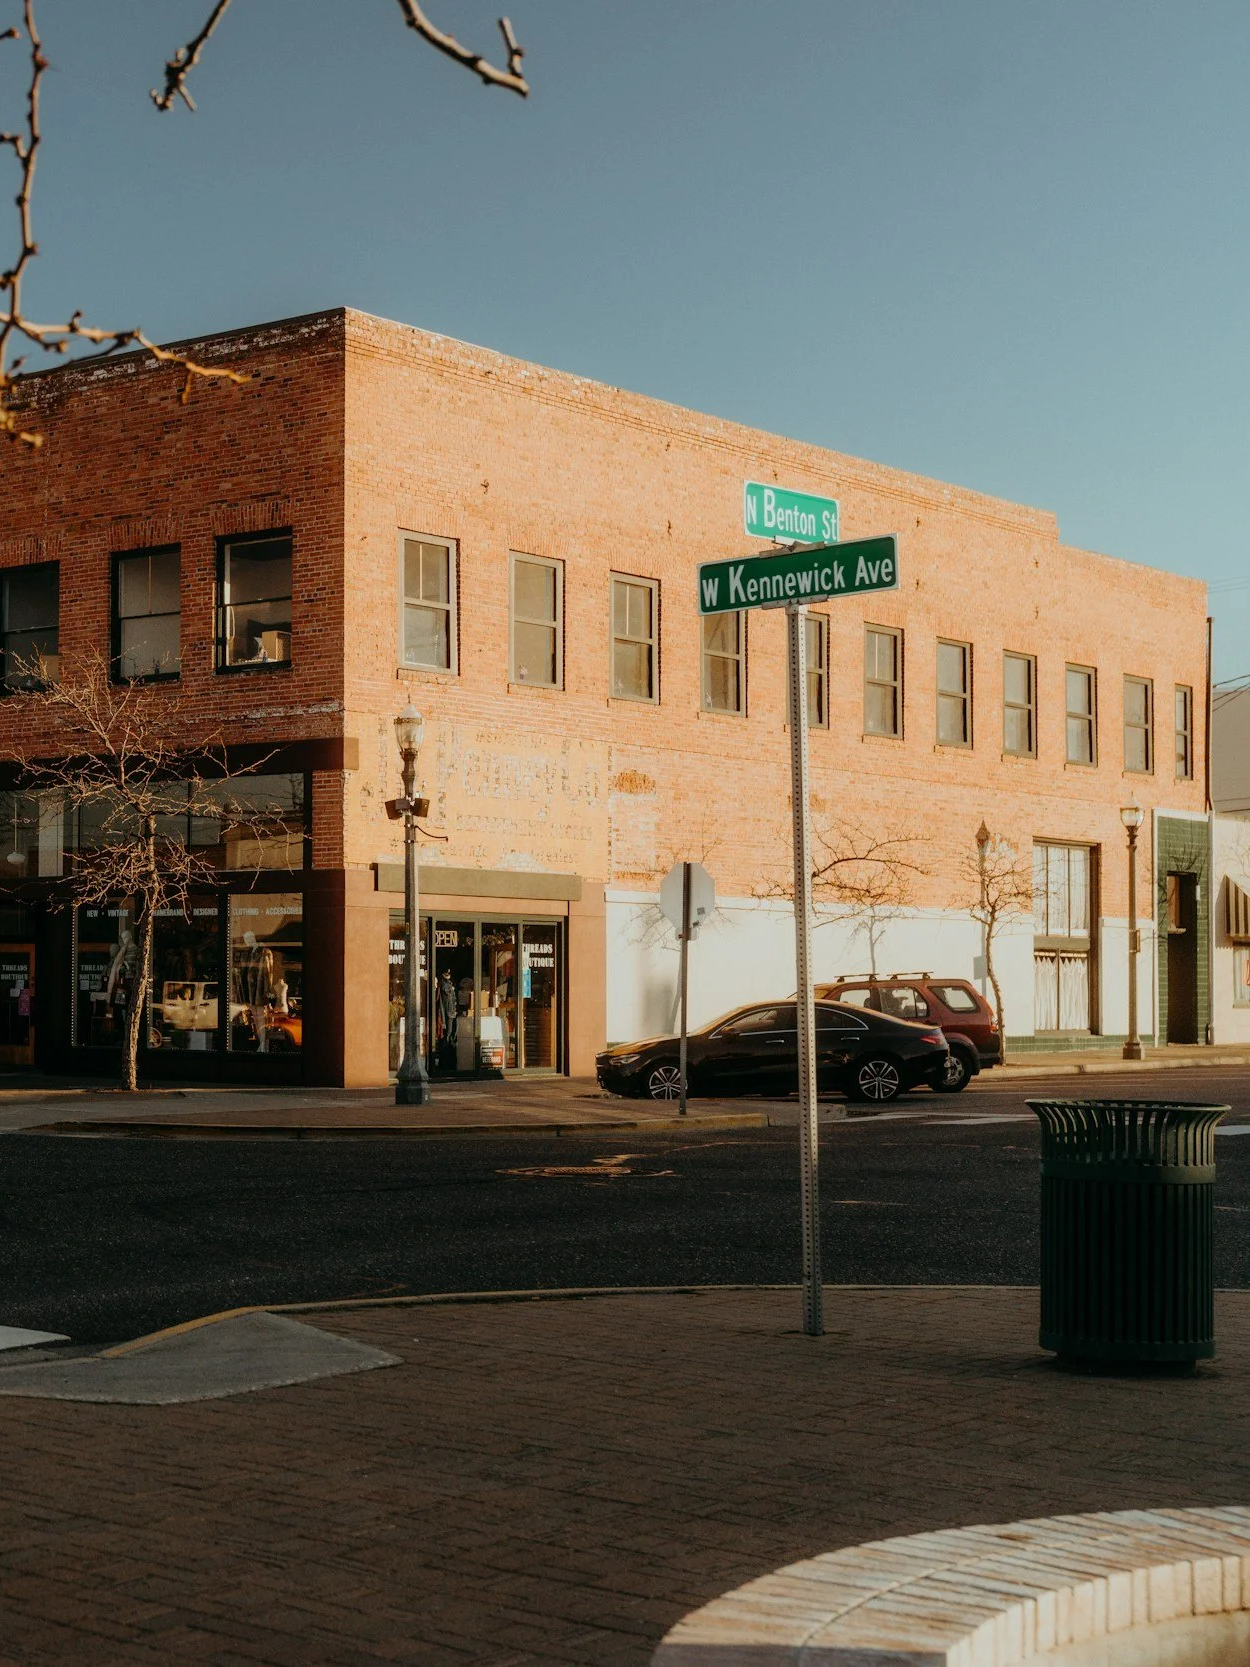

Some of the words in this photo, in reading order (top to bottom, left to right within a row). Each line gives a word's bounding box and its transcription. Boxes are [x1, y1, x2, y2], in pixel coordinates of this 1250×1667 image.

[747, 495, 757, 525] N
[763, 488, 817, 537] Benton
[822, 510, 837, 540] St
[702, 577, 719, 608] W
[728, 562, 847, 604] Kennewick
[854, 555, 894, 587] Ave
[87, 909, 98, 917] NEW
[108, 909, 128, 917] VINTAGE
[193, 908, 218, 916] DESIGNER
[232, 908, 259, 916] CLOTHING
[389, 939, 425, 951] THRS
[522, 943, 553, 954] THREADS
[2, 964, 28, 972] THREADS
